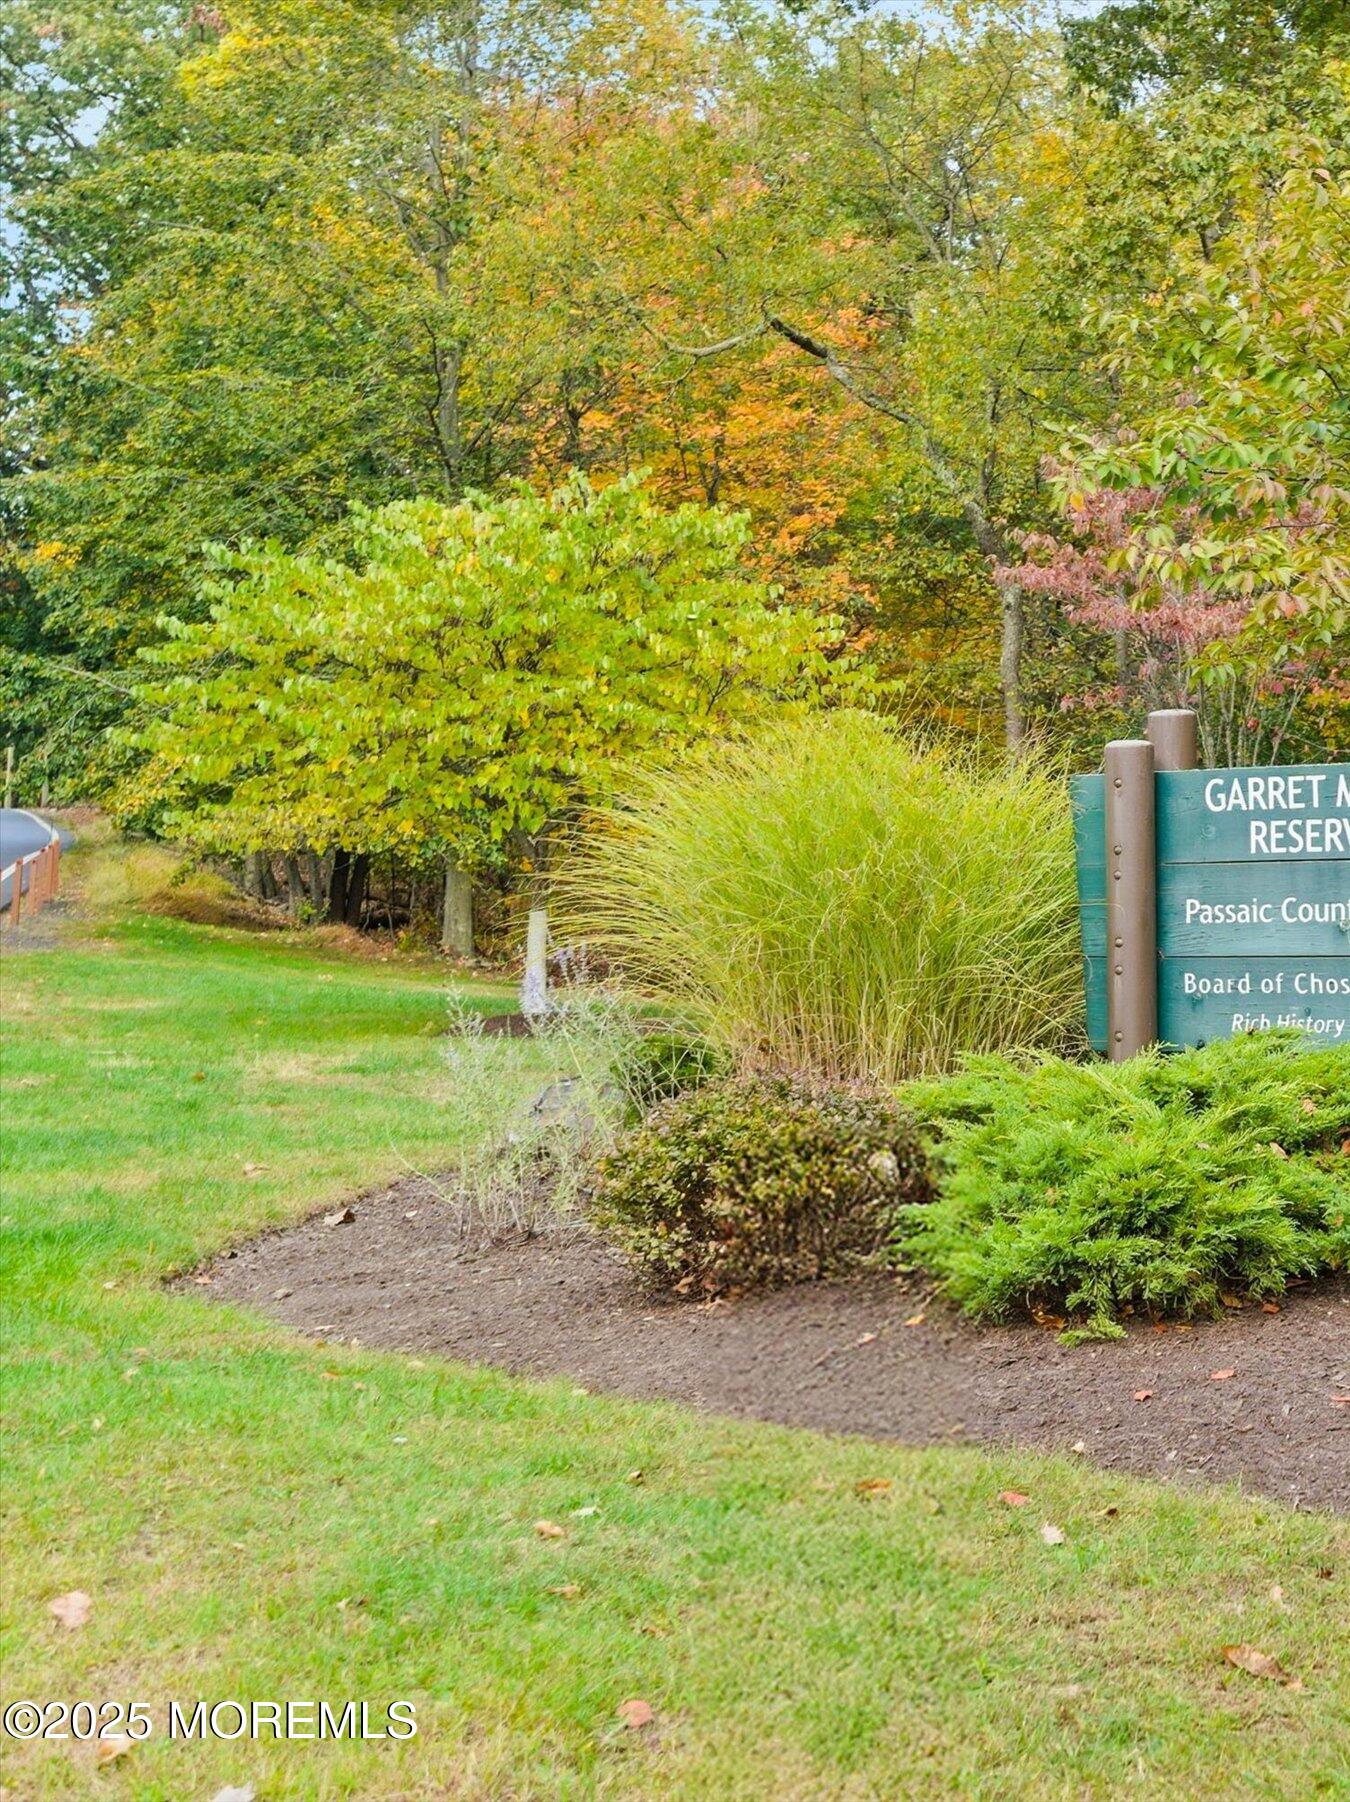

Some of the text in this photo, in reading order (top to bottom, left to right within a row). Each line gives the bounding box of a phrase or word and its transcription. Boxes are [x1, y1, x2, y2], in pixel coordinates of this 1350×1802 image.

[1205, 775, 1326, 812] GARRET
[1185, 898, 1273, 924] Passaic
[1184, 973, 1251, 995] Board
[1261, 973, 1284, 994] of
[1231, 1013, 1271, 1032] Rich
[1277, 1015, 1346, 1036] History
